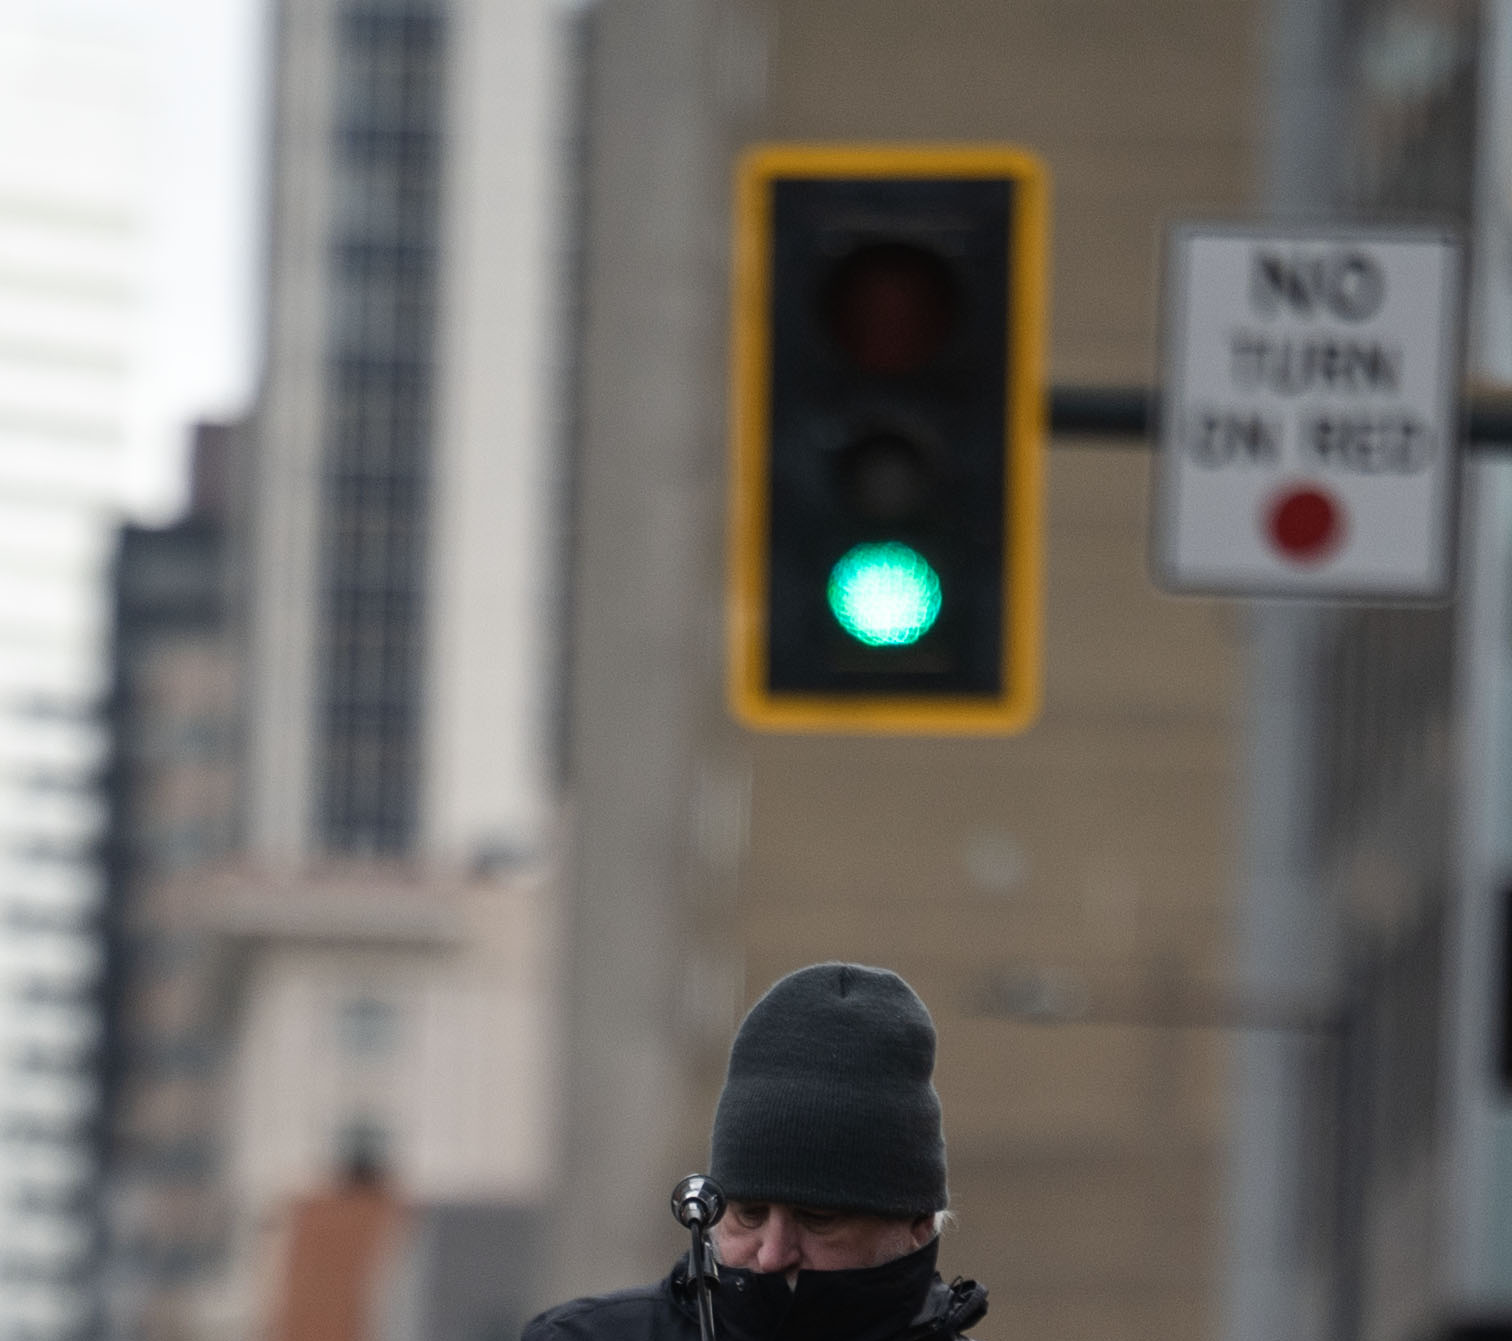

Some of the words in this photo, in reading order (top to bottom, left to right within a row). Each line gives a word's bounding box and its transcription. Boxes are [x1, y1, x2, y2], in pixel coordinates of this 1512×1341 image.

[1253, 248, 1385, 320] NO
[1230, 331, 1401, 394] TURN
[1187, 409, 1277, 471] ON
[1301, 412, 1435, 475] RED
